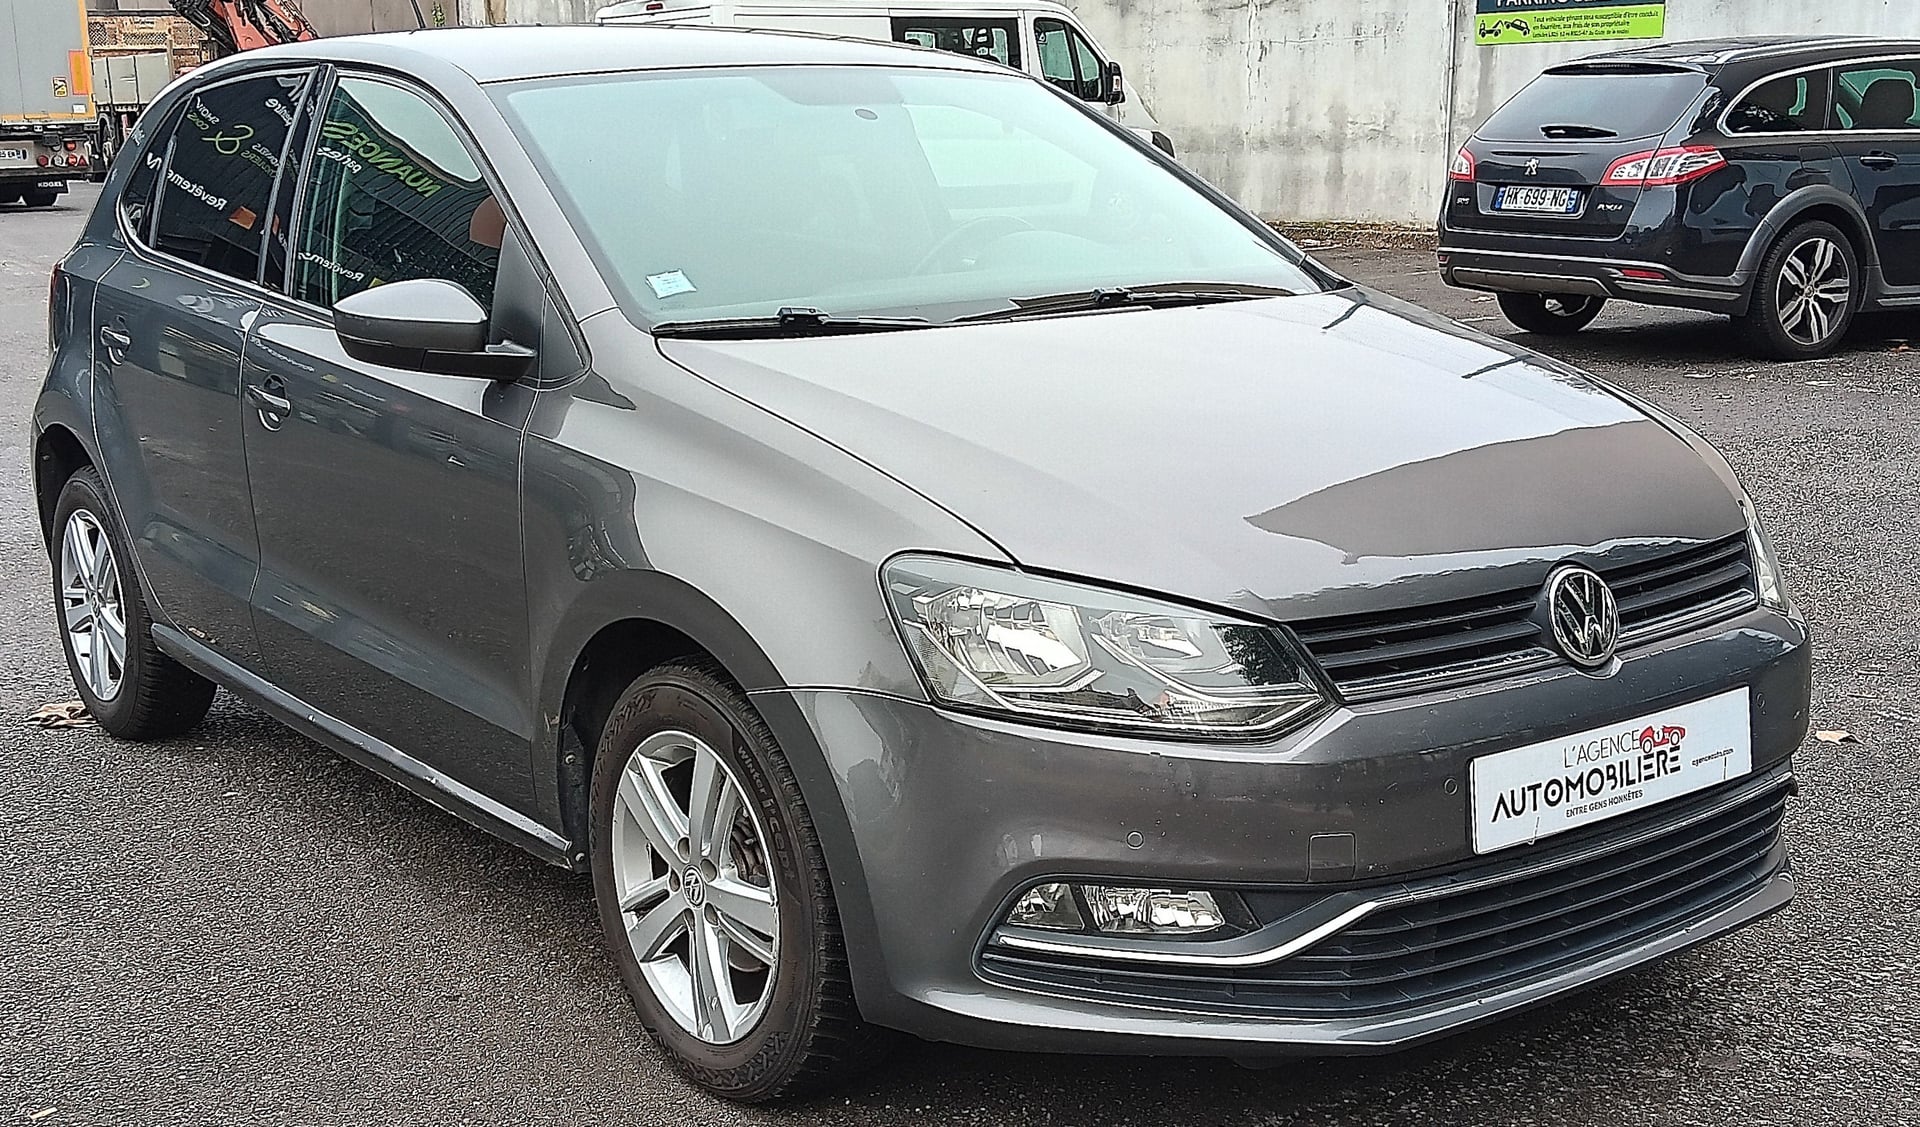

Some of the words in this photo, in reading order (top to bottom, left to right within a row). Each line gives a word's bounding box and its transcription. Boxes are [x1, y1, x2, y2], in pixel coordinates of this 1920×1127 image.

[1504, 187, 1568, 207] HK-699-NG
[1563, 728, 1641, 769] L'AGENCE
[1566, 804, 1588, 818] ENTRE
[1588, 799, 1608, 812] GENS
[1608, 789, 1643, 807] HONNÊTES
